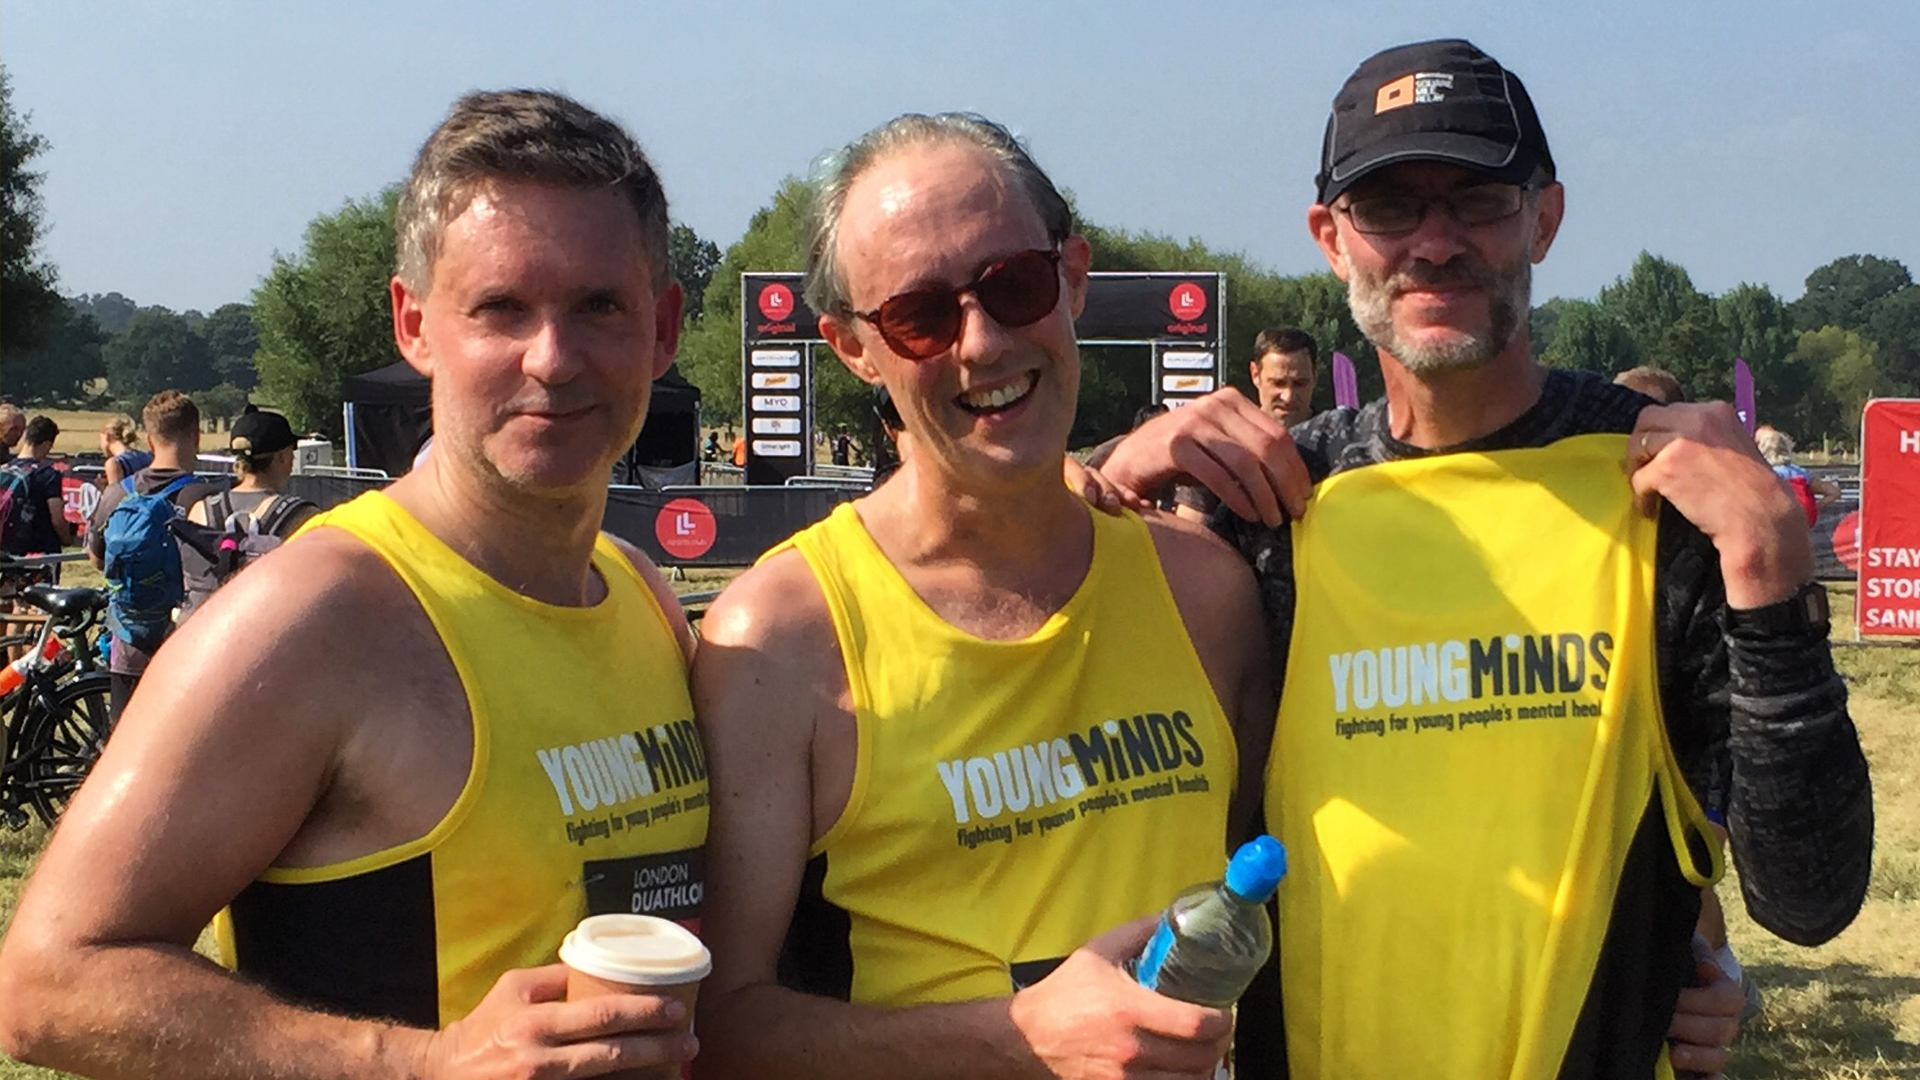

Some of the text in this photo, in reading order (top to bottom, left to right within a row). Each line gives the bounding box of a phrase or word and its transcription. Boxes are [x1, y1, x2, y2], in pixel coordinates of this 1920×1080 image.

[757, 322, 796, 335] original
[1167, 323, 1208, 335] original
[1867, 547, 1920, 568] STAY
[1335, 717, 1385, 740] fighting
[1390, 713, 1409, 731] for
[1413, 712, 1454, 733] young
[1459, 703, 1512, 730] people's
[1518, 699, 1566, 720] mental
[957, 823, 1013, 850] fighting
[1015, 817, 1034, 836] for
[1079, 787, 1129, 817] people's
[1131, 776, 1174, 802] mental
[566, 818, 610, 846] fighting
[634, 863, 688, 889] LONDON
